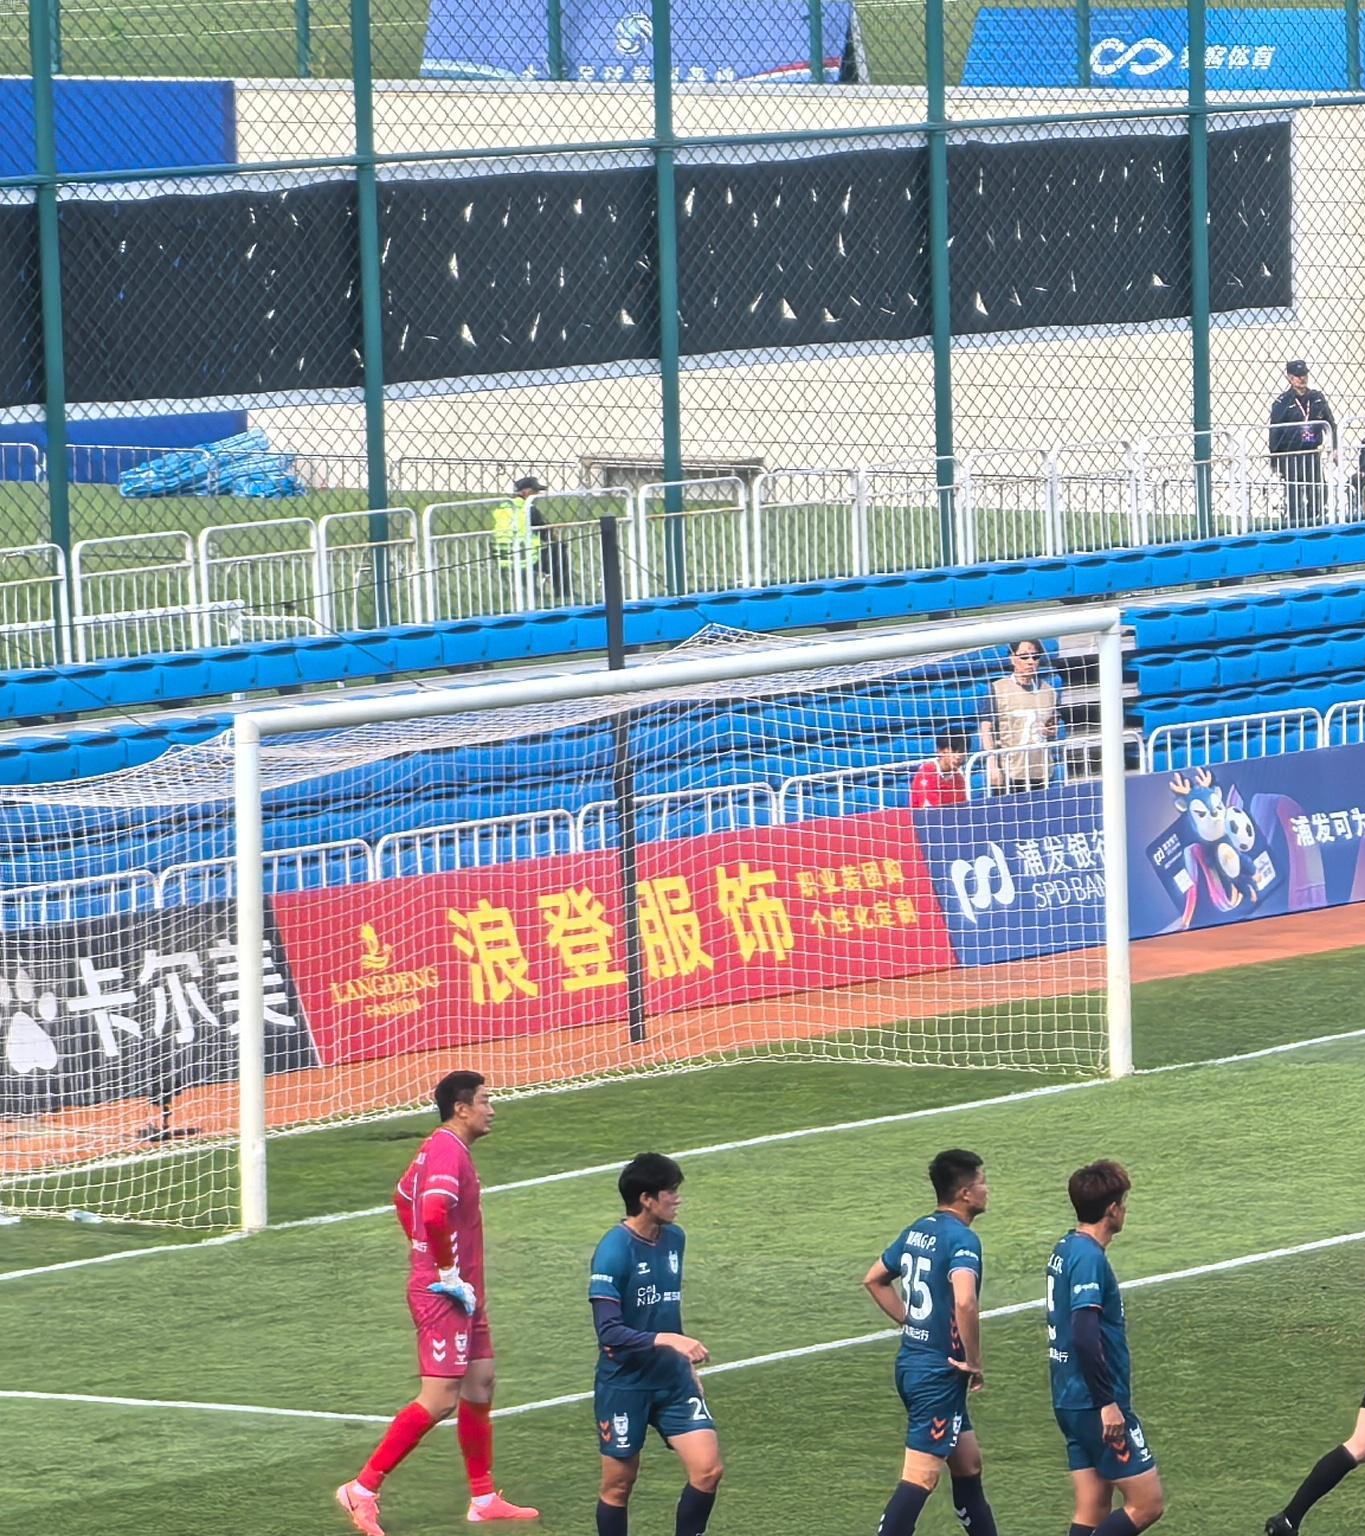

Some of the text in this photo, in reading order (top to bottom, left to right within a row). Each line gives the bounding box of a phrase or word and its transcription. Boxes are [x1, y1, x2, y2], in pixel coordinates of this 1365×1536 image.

[1032, 874, 1106, 908] SPD BAN
[447, 862, 795, 1006] 浪登服饰
[66, 939, 297, 1058] 卡尔美
[330, 967, 439, 1004] LANGDENG
[901, 1253, 933, 1320] 35
